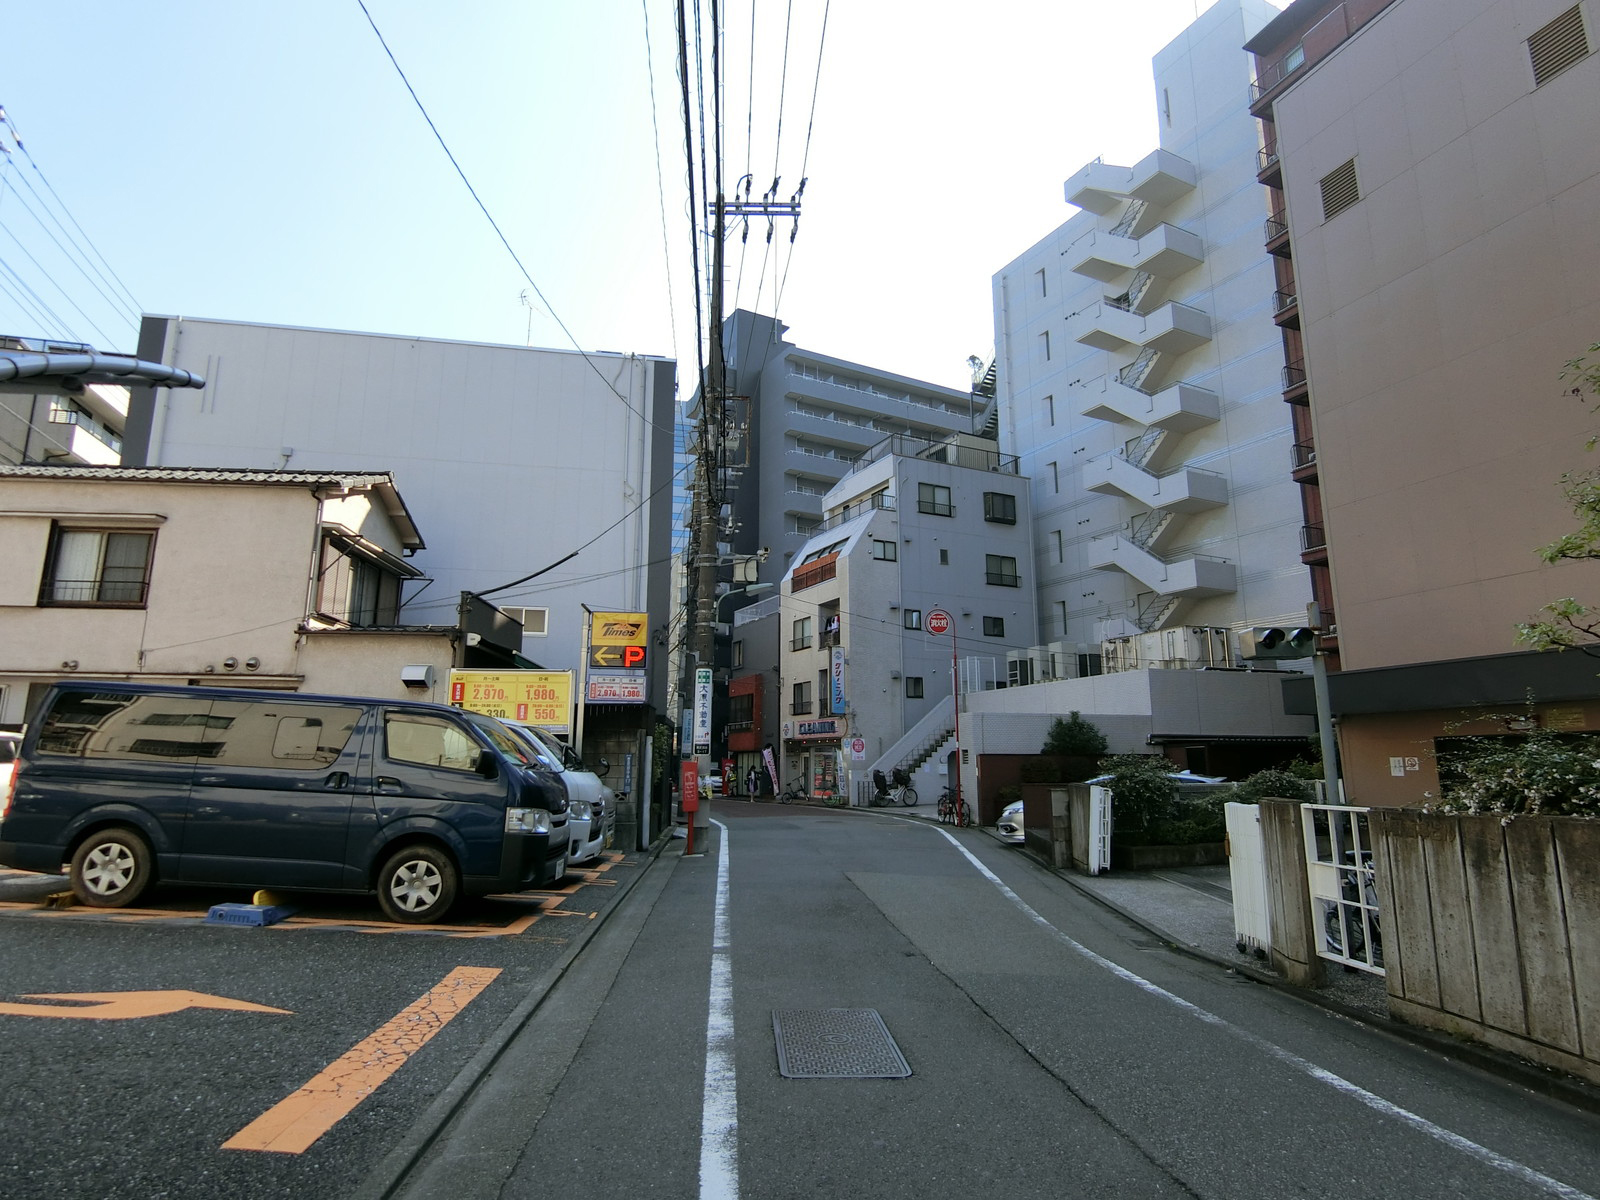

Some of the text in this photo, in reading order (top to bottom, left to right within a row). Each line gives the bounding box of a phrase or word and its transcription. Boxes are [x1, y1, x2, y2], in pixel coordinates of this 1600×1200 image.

[601, 623, 637, 637] Times
[930, 619, 947, 627] 消火栓
[625, 646, 644, 667] P
[835, 662, 843, 704] クリーニング
